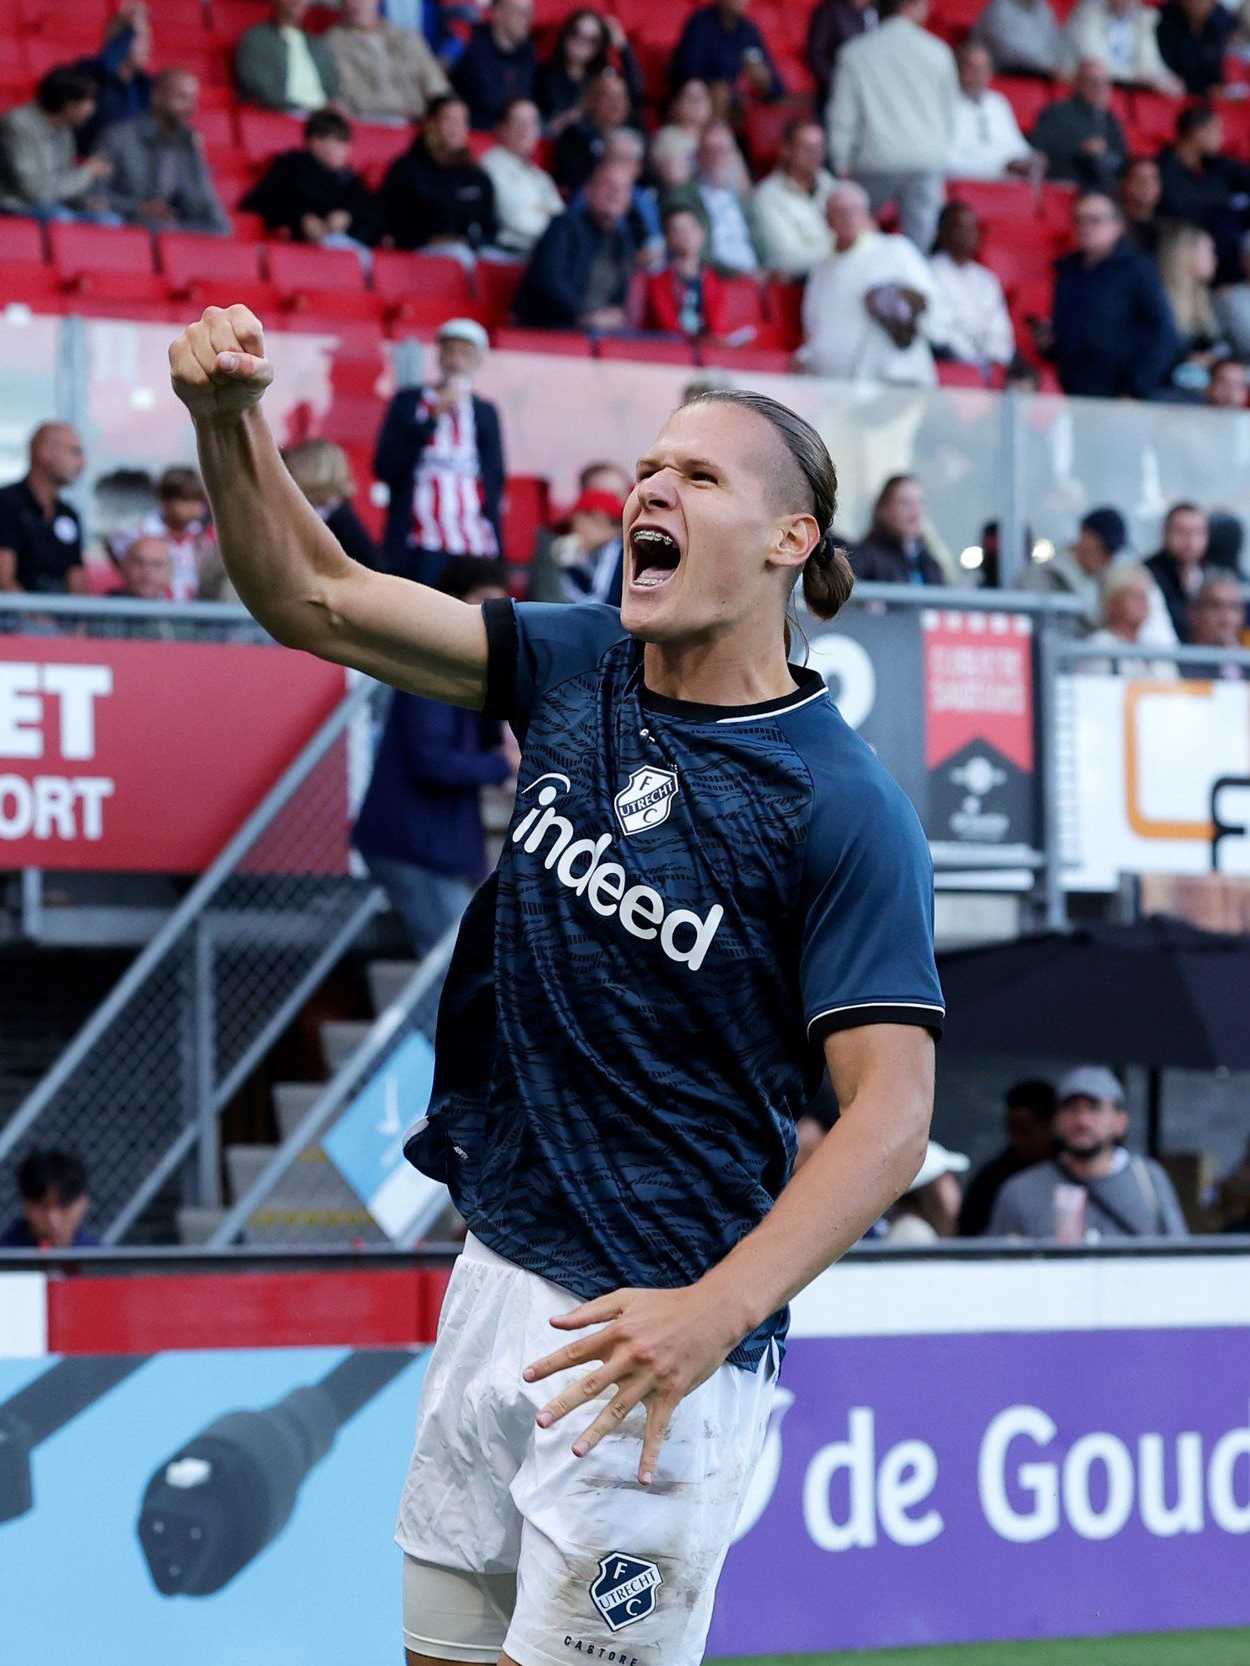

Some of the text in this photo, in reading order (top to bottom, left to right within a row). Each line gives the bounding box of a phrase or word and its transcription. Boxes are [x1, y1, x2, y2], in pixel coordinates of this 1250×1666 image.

[619, 779, 673, 817] UTRECHT
[511, 785, 724, 972] indeed
[802, 1404, 945, 1552] de
[598, 1569, 657, 1610] UTRECHT
[613, 1561, 628, 1580] F
[563, 1635, 638, 1666] CASTORE
